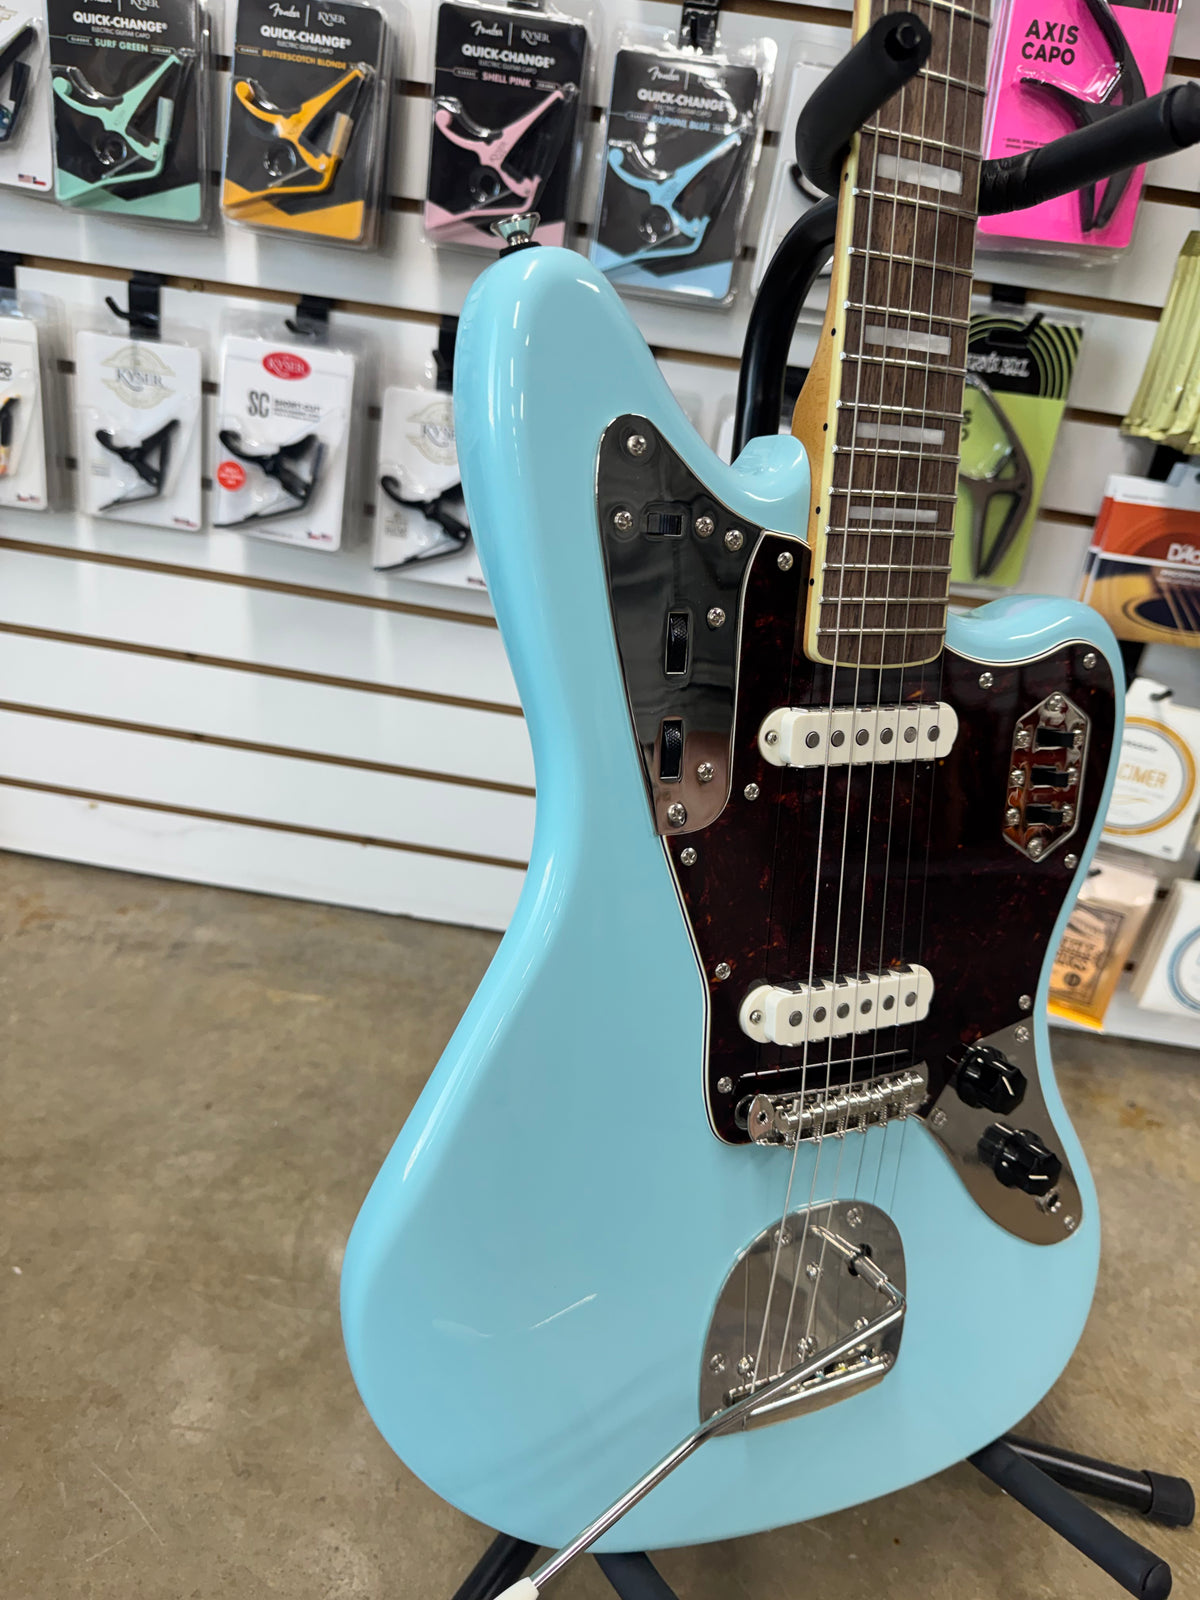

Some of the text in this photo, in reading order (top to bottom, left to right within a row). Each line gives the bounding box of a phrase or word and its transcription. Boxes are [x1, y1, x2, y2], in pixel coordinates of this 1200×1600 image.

[268, 2, 300, 18] Fender
[317, 11, 347, 27] KYSER
[91, 26, 151, 40] ELECTRIC GUITAR CAPO
[470, 20, 503, 37] Fender
[1025, 19, 1080, 45] AXIS
[94, 38, 117, 48] SURF
[119, 41, 148, 53] GREEN
[521, 29, 551, 46] KYSER
[262, 49, 316, 65] BUTTERSCOTCH
[317, 58, 347, 70] BLONDE
[1021, 42, 1076, 66] CAPO
[482, 71, 507, 84] SHELL
[509, 76, 532, 88] PINK
[647, 66, 680, 82] Fender
[268, 357, 305, 378] KYSER
[115, 367, 167, 392] KYSER
[248, 390, 270, 418] SC
